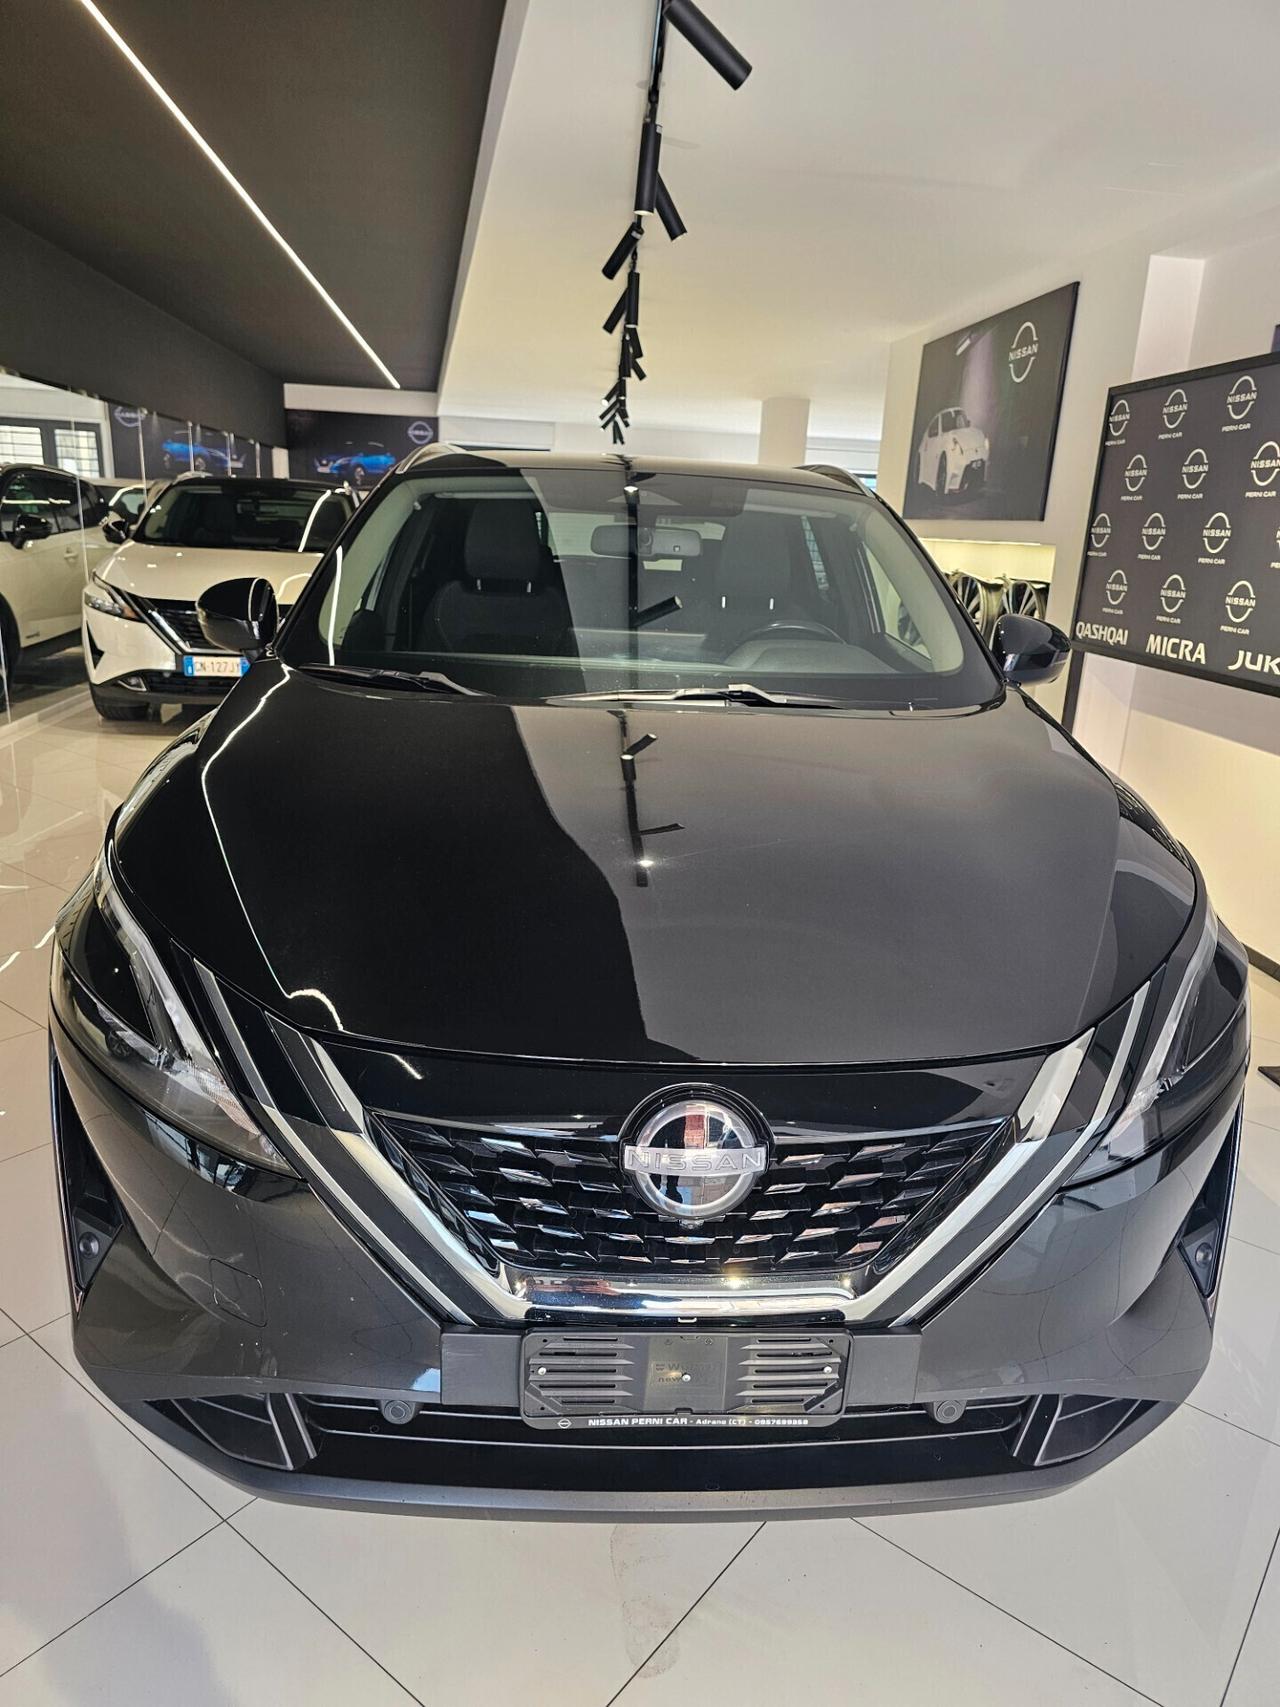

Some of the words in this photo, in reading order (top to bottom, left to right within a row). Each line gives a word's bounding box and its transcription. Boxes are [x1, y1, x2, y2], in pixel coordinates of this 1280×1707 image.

[1009, 343, 1038, 361] NISSAN
[1227, 391, 1257, 403] NISSAN
[1162, 404, 1188, 413] NISSAN
[1124, 469, 1147, 477] NISSAN
[1182, 465, 1209, 473] NISSAN
[1142, 527, 1166, 535] NISSAN
[1202, 529, 1232, 537] NISSAN
[1106, 583, 1128, 592] NISSAN
[1160, 589, 1186, 598] NISSAN
[1225, 596, 1256, 607] NISSAN
[1075, 621, 1129, 646] QASHQAI
[1145, 633, 1206, 665] MICRA
[628, 1152, 763, 1171] NISSAN
[588, 1418, 629, 1426] NISSAN
[665, 1417, 688, 1425] CAR
